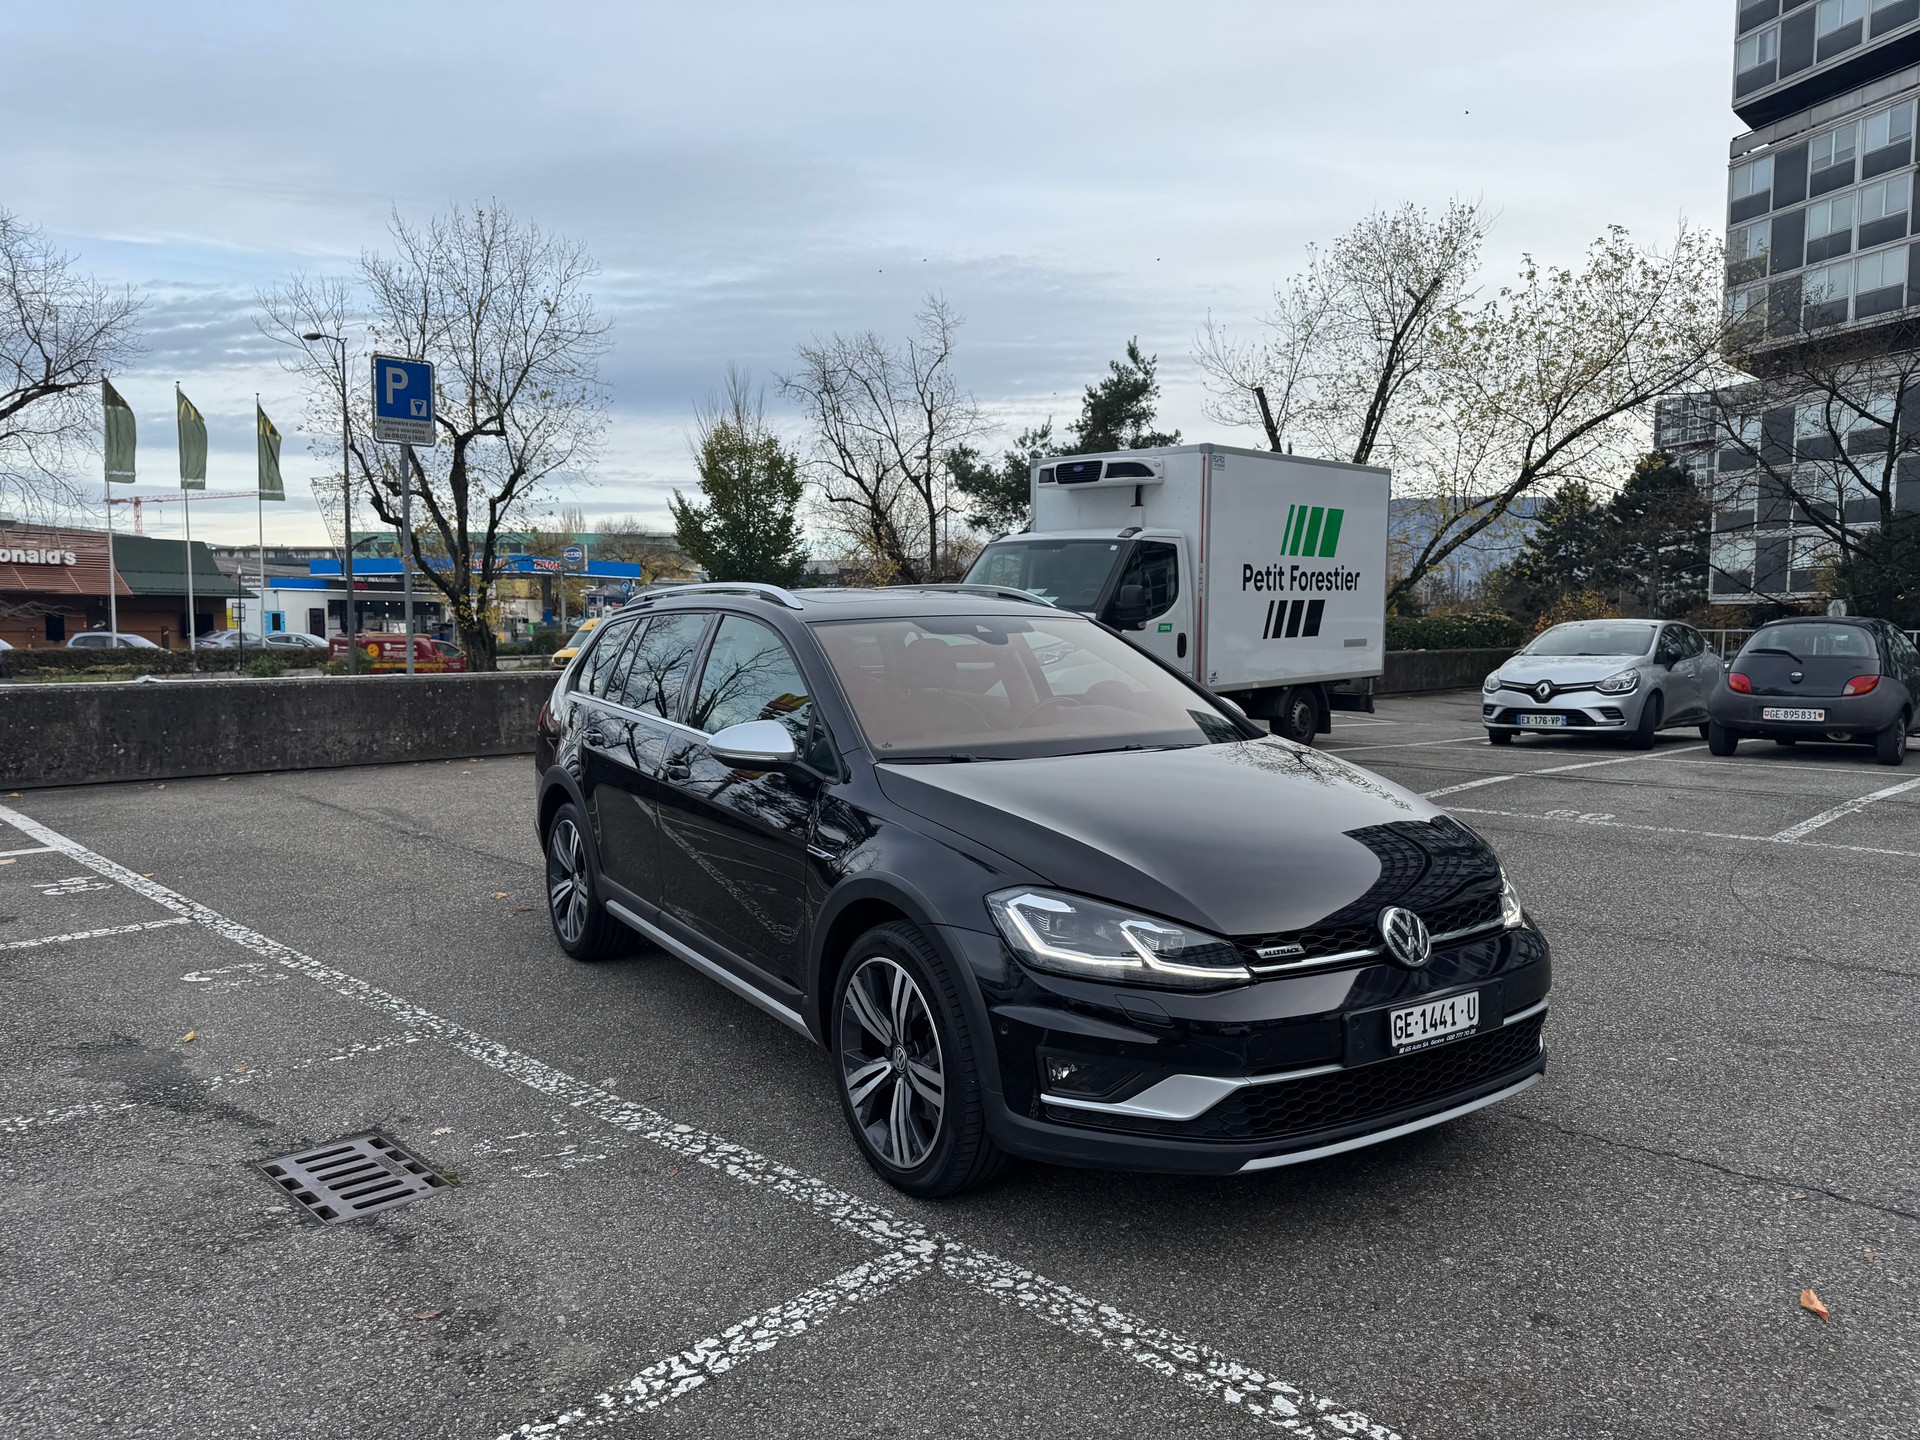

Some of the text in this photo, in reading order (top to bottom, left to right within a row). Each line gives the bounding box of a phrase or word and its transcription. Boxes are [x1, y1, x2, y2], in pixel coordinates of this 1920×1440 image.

[386, 366, 409, 405] P
[1242, 563, 1361, 592] Petit Forestier
[1263, 947, 1300, 957] ALLTRACK
